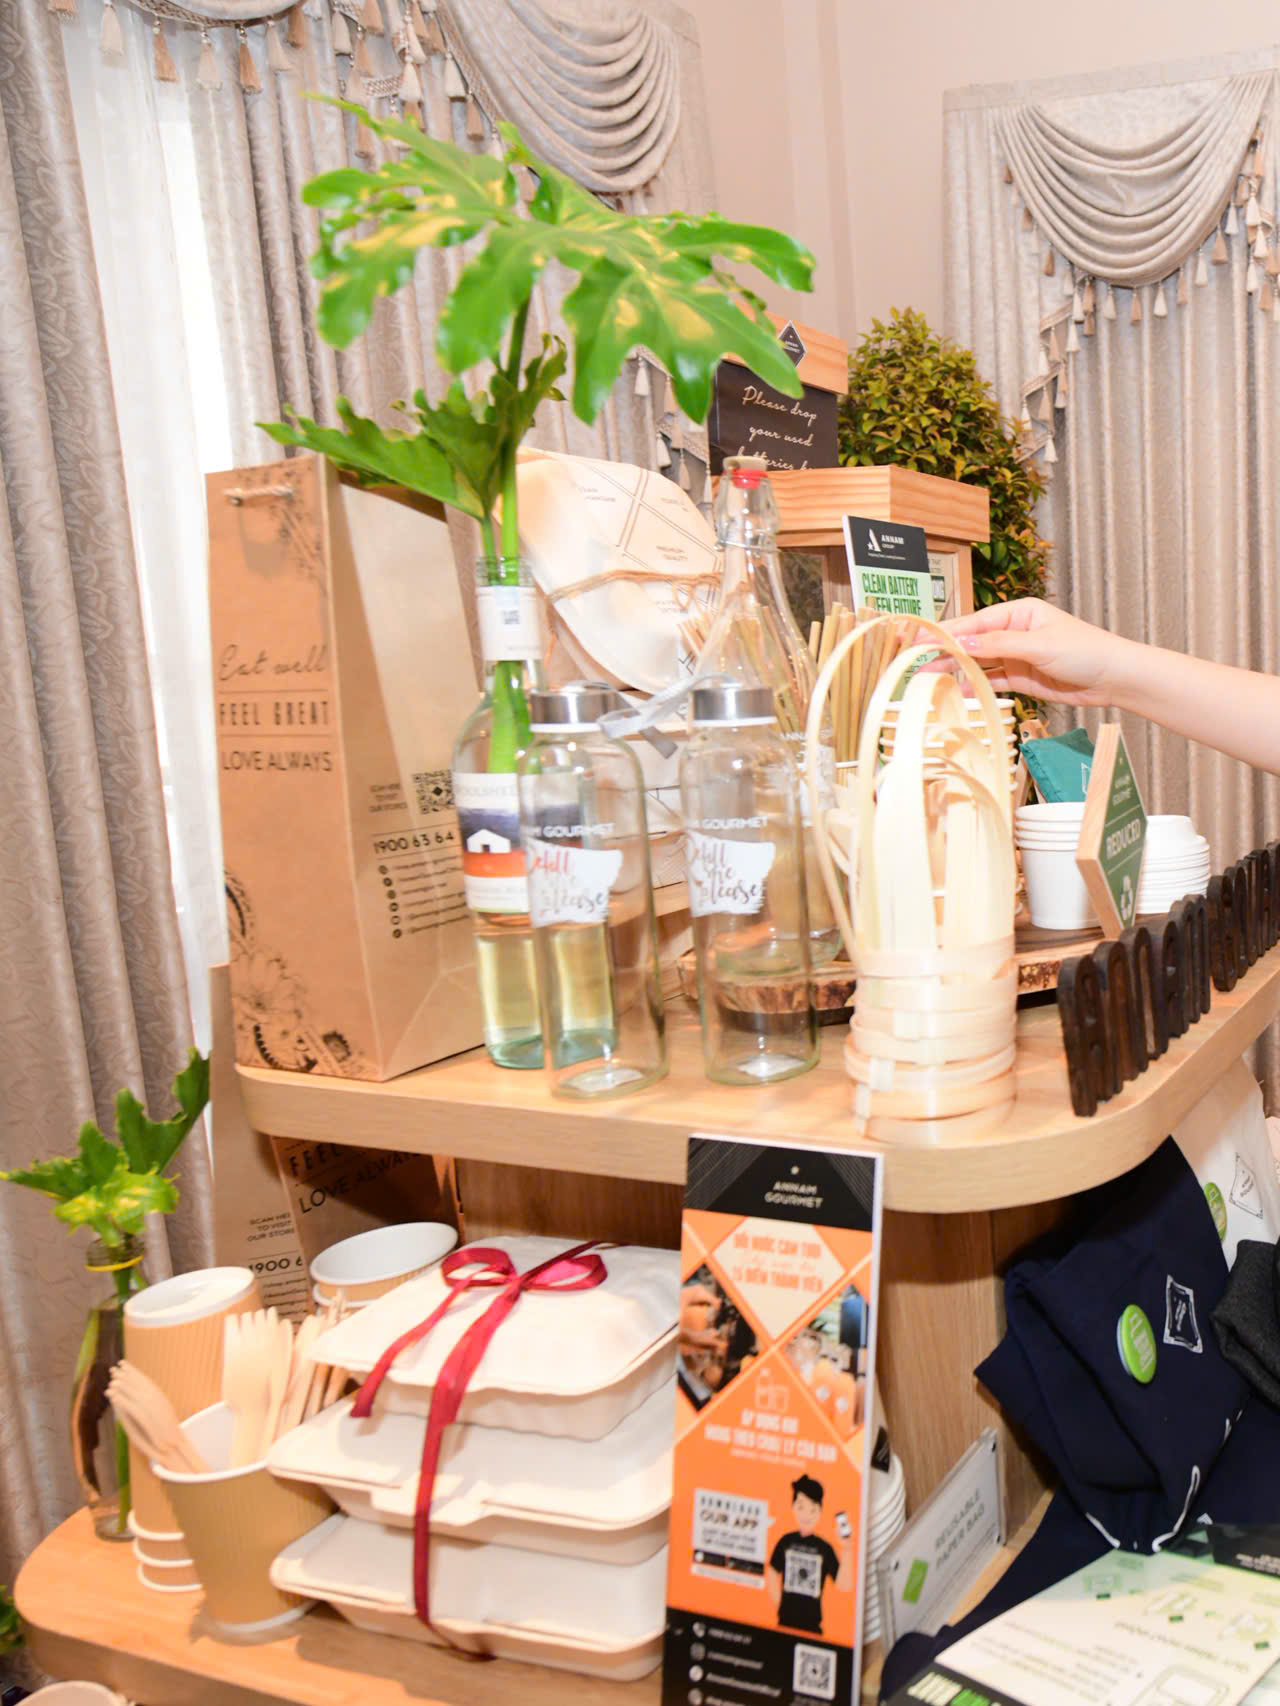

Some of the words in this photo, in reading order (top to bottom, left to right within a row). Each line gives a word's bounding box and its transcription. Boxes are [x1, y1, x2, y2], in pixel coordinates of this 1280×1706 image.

[742, 385, 788, 406] Please
[790, 402, 817, 427] drop
[749, 426, 781, 442] your
[784, 433, 813, 447] used
[862, 572, 887, 594] CLEAN
[887, 575, 919, 597] BATTERY
[219, 644, 268, 681] Eat
[273, 645, 327, 675] well
[219, 702, 261, 726] FEEL
[222, 751, 263, 771] LOVE
[268, 751, 332, 772] ALWAYS
[1106, 818, 1141, 860] REDUCED
[299, 1175, 352, 1214] LOVE
[764, 1191, 824, 1209] GOURMET
